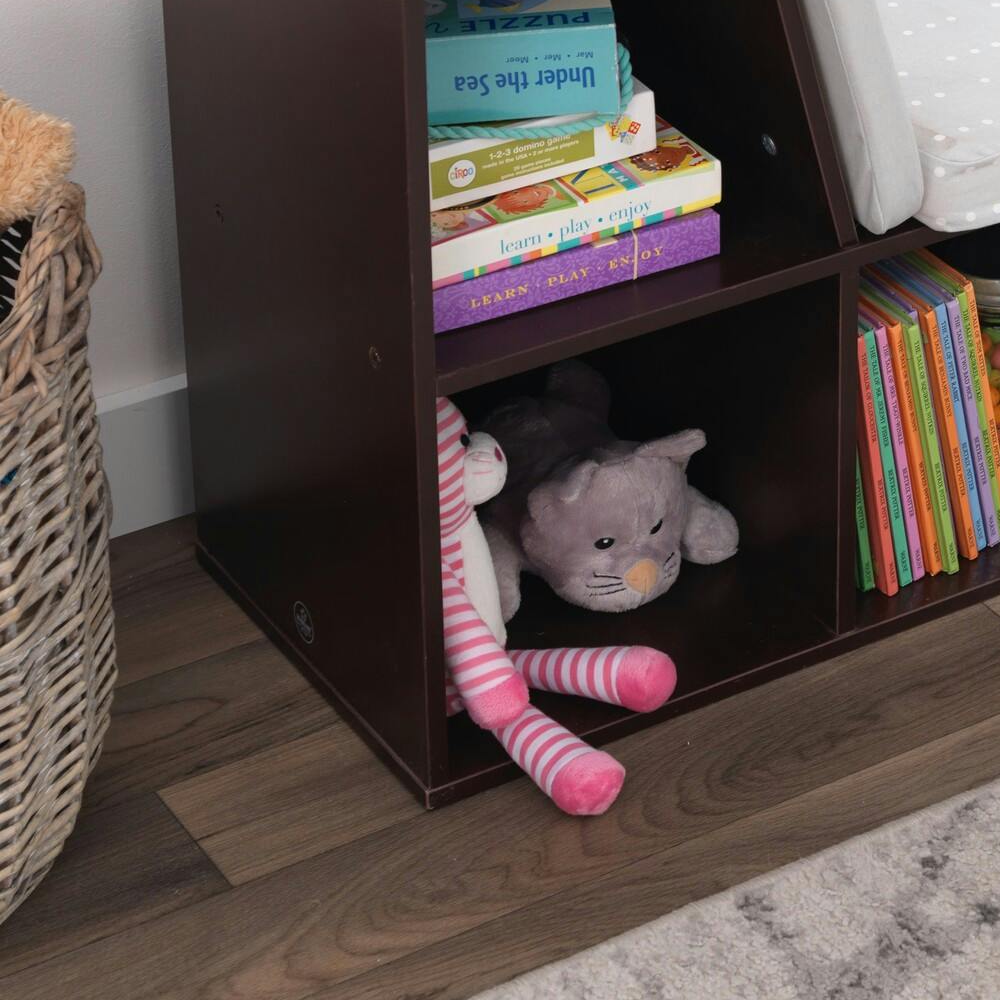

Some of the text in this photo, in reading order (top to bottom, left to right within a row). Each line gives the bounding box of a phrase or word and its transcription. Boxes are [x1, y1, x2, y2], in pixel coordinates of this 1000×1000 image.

[461, 11, 590, 33] PUZZLE
[454, 67, 596, 96] Under the Sea
[489, 148, 511, 160] 1-2-3
[513, 140, 545, 153] domino
[500, 199, 651, 254] learn play enjoy
[470, 283, 528, 309] LEARN
[548, 267, 590, 288] PLAY
